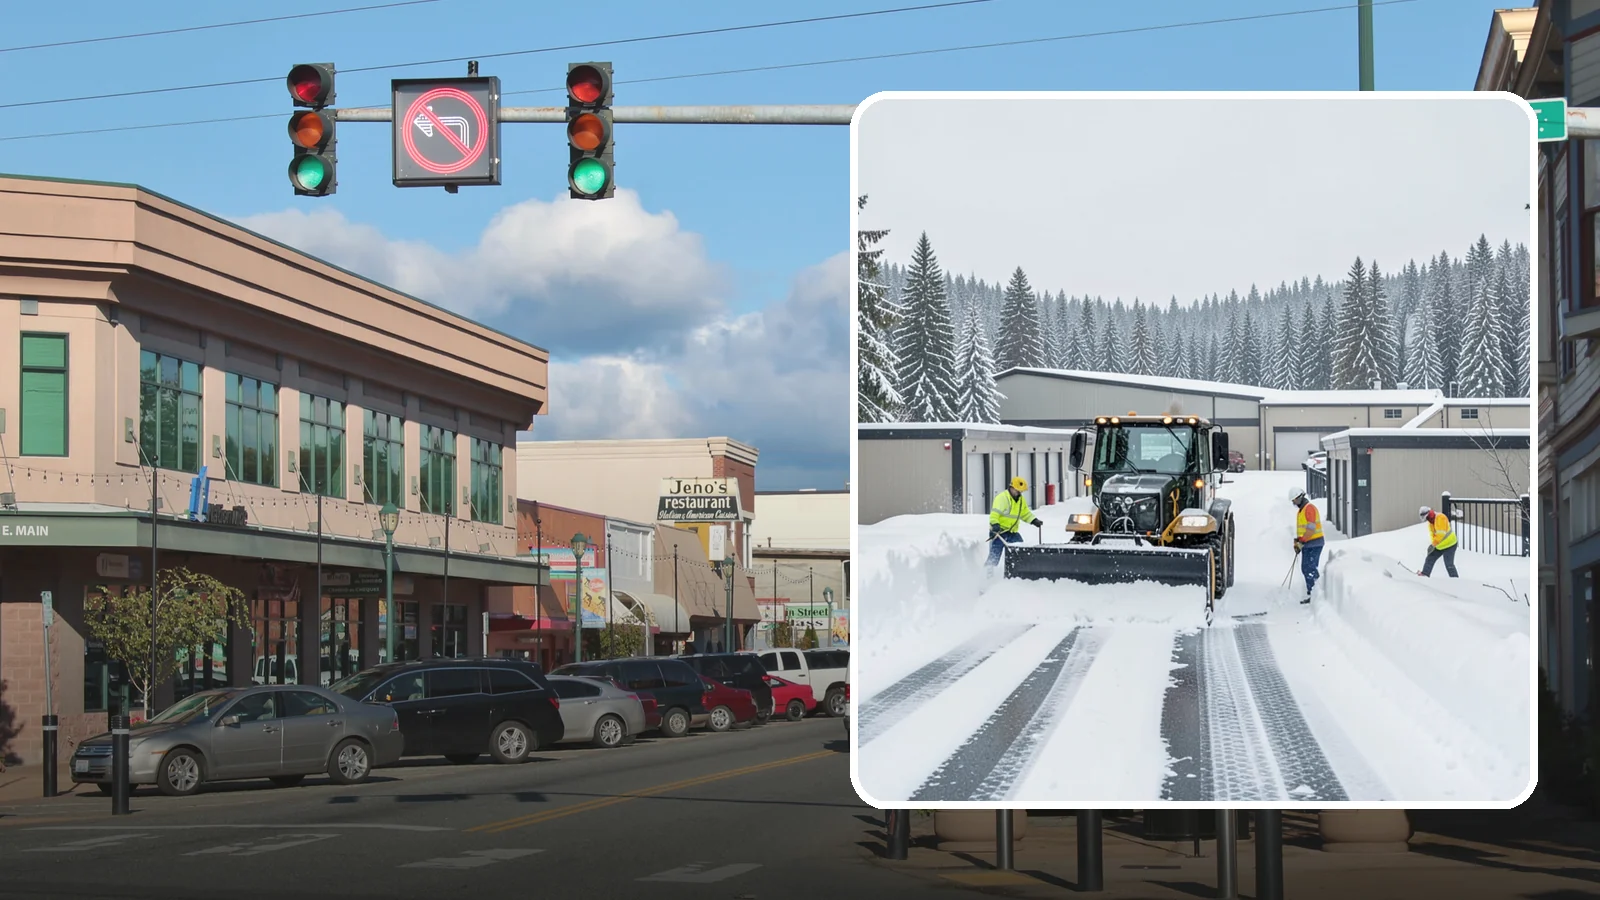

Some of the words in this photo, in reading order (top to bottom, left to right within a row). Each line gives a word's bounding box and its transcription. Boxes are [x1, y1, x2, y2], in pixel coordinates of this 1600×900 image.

[670, 480, 728, 494] Jeno's
[665, 496, 731, 509] restaurant
[658, 510, 682, 520] Italian
[686, 510, 714, 519] American
[715, 509, 737, 519] Cuisine
[2, 525, 13, 536] E.
[16, 525, 49, 536] MAIN
[797, 607, 828, 616] Street
